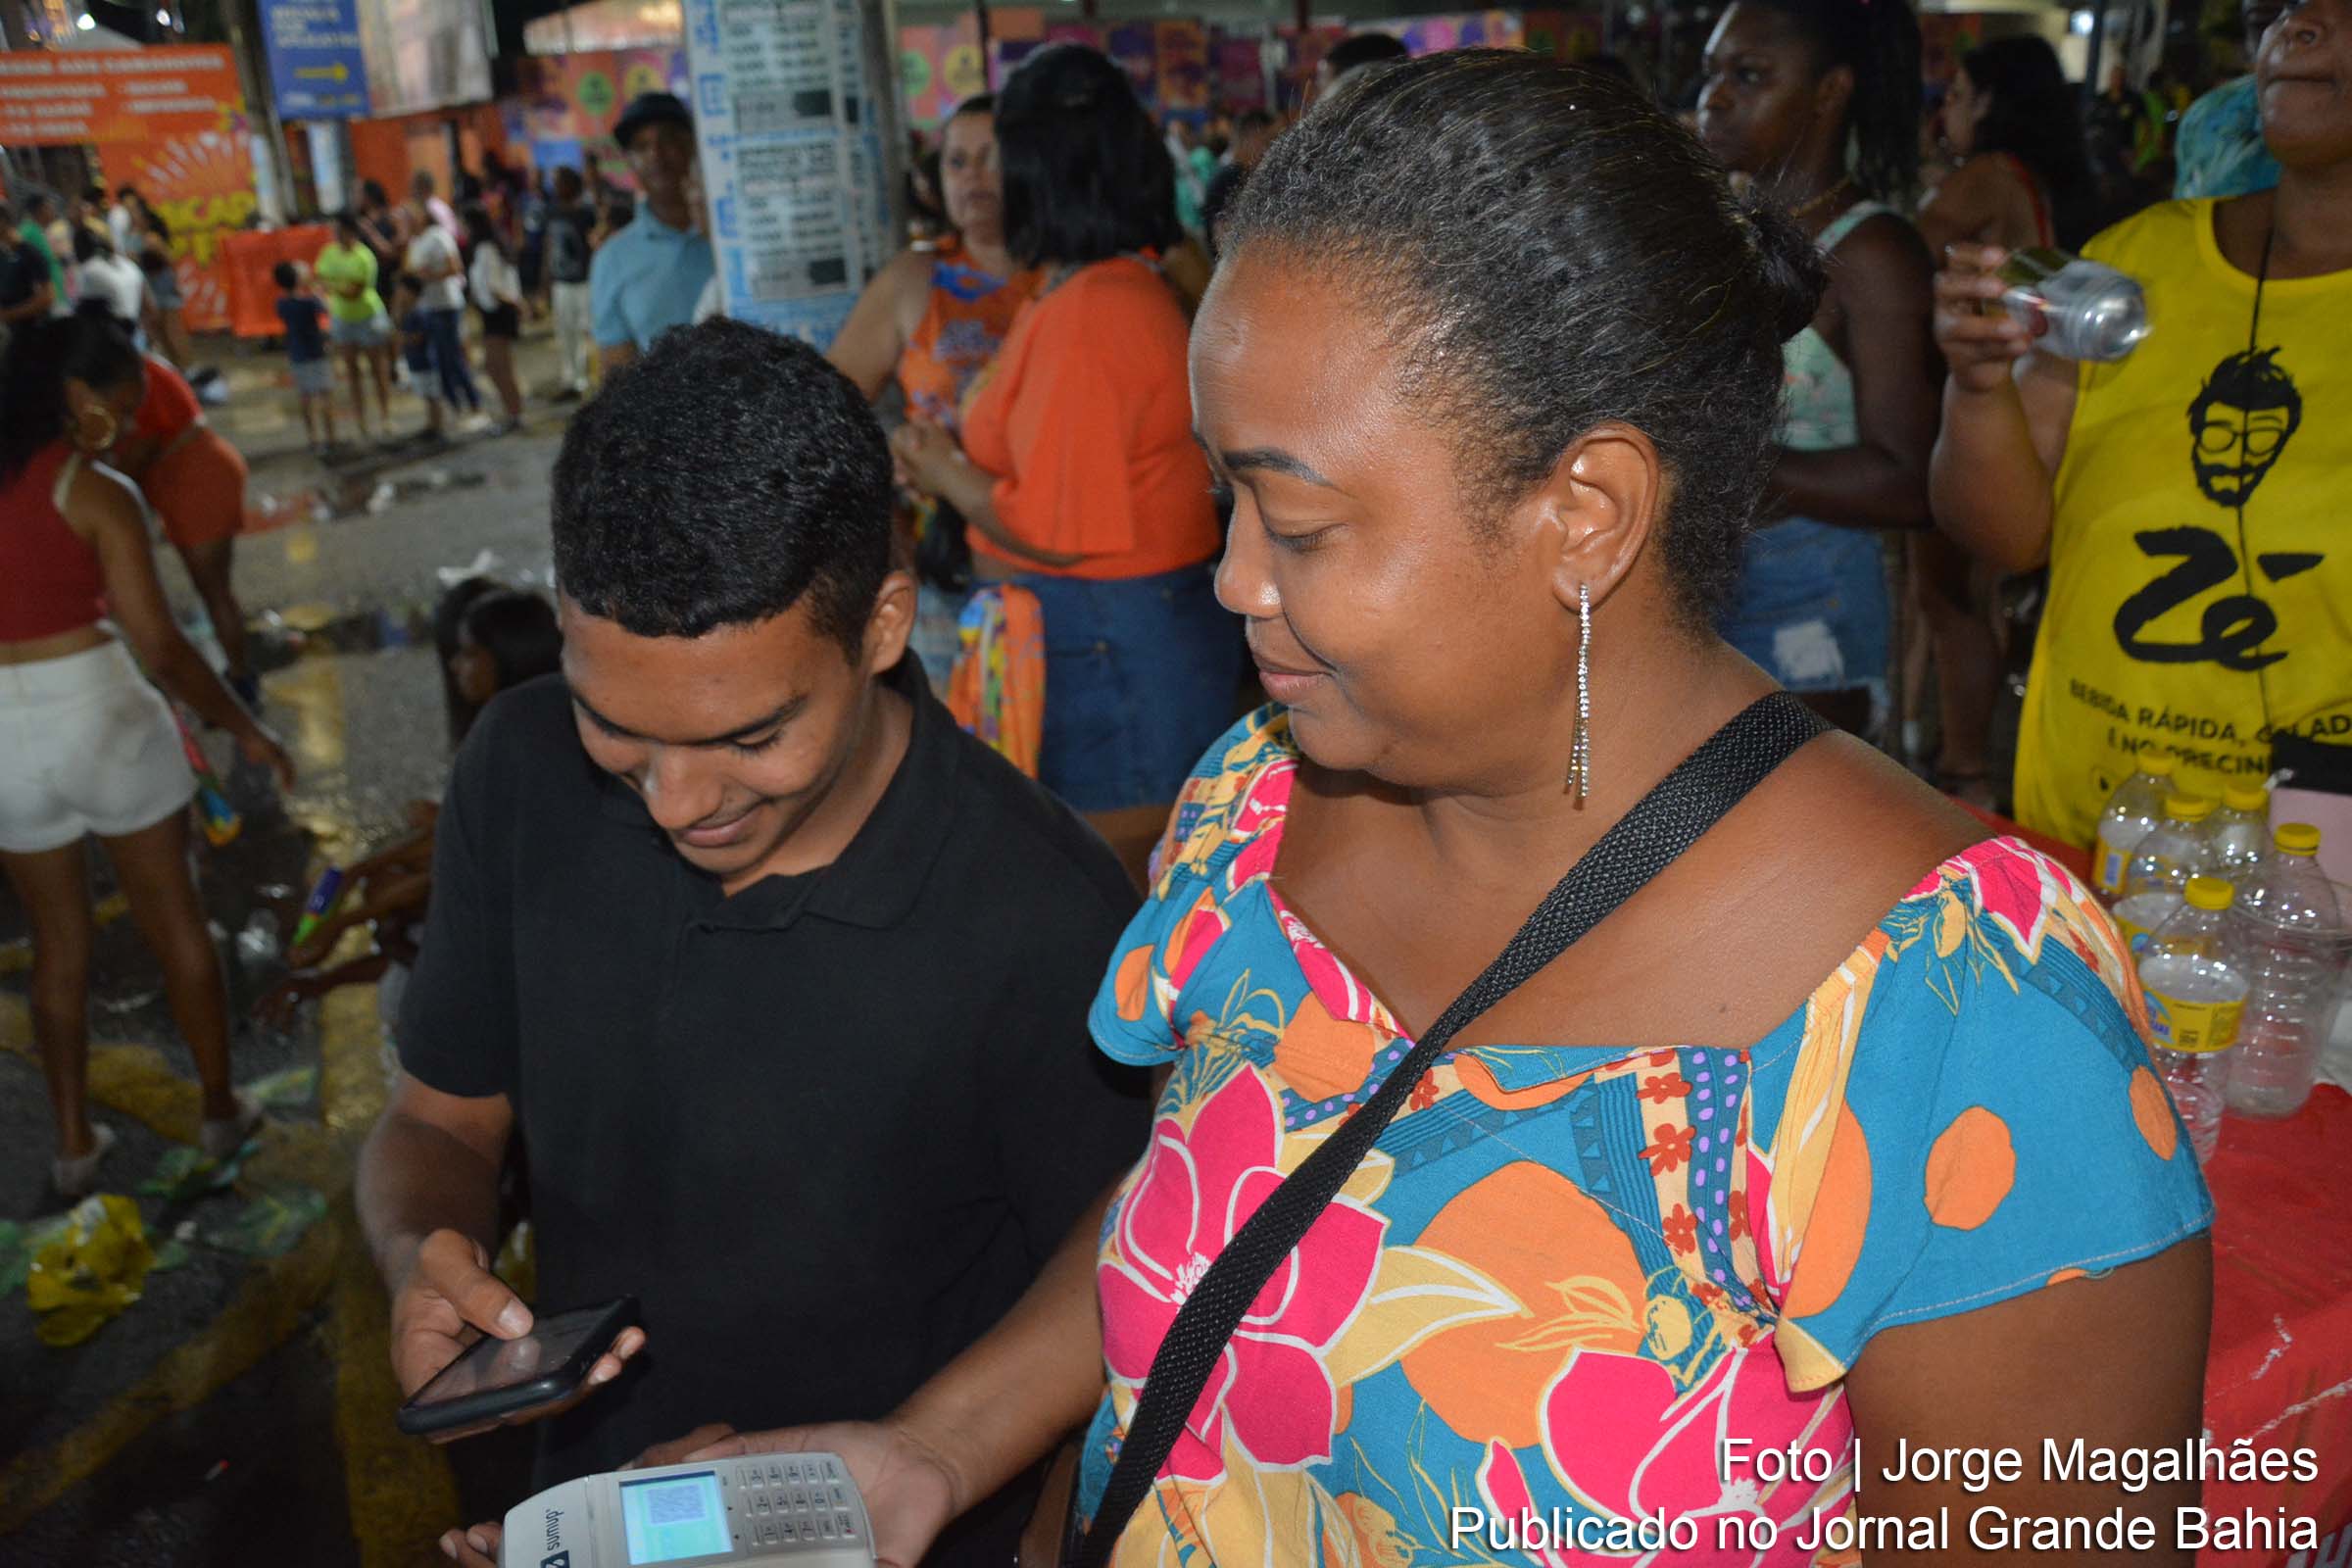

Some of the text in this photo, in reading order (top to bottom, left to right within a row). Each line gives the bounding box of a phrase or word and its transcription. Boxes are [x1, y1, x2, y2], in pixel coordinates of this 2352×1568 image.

[2113, 524, 2326, 672] Zé
[2256, 713, 2350, 745] GAD
[2165, 745, 2265, 775] RECIN
[545, 1509, 564, 1551] sumup
